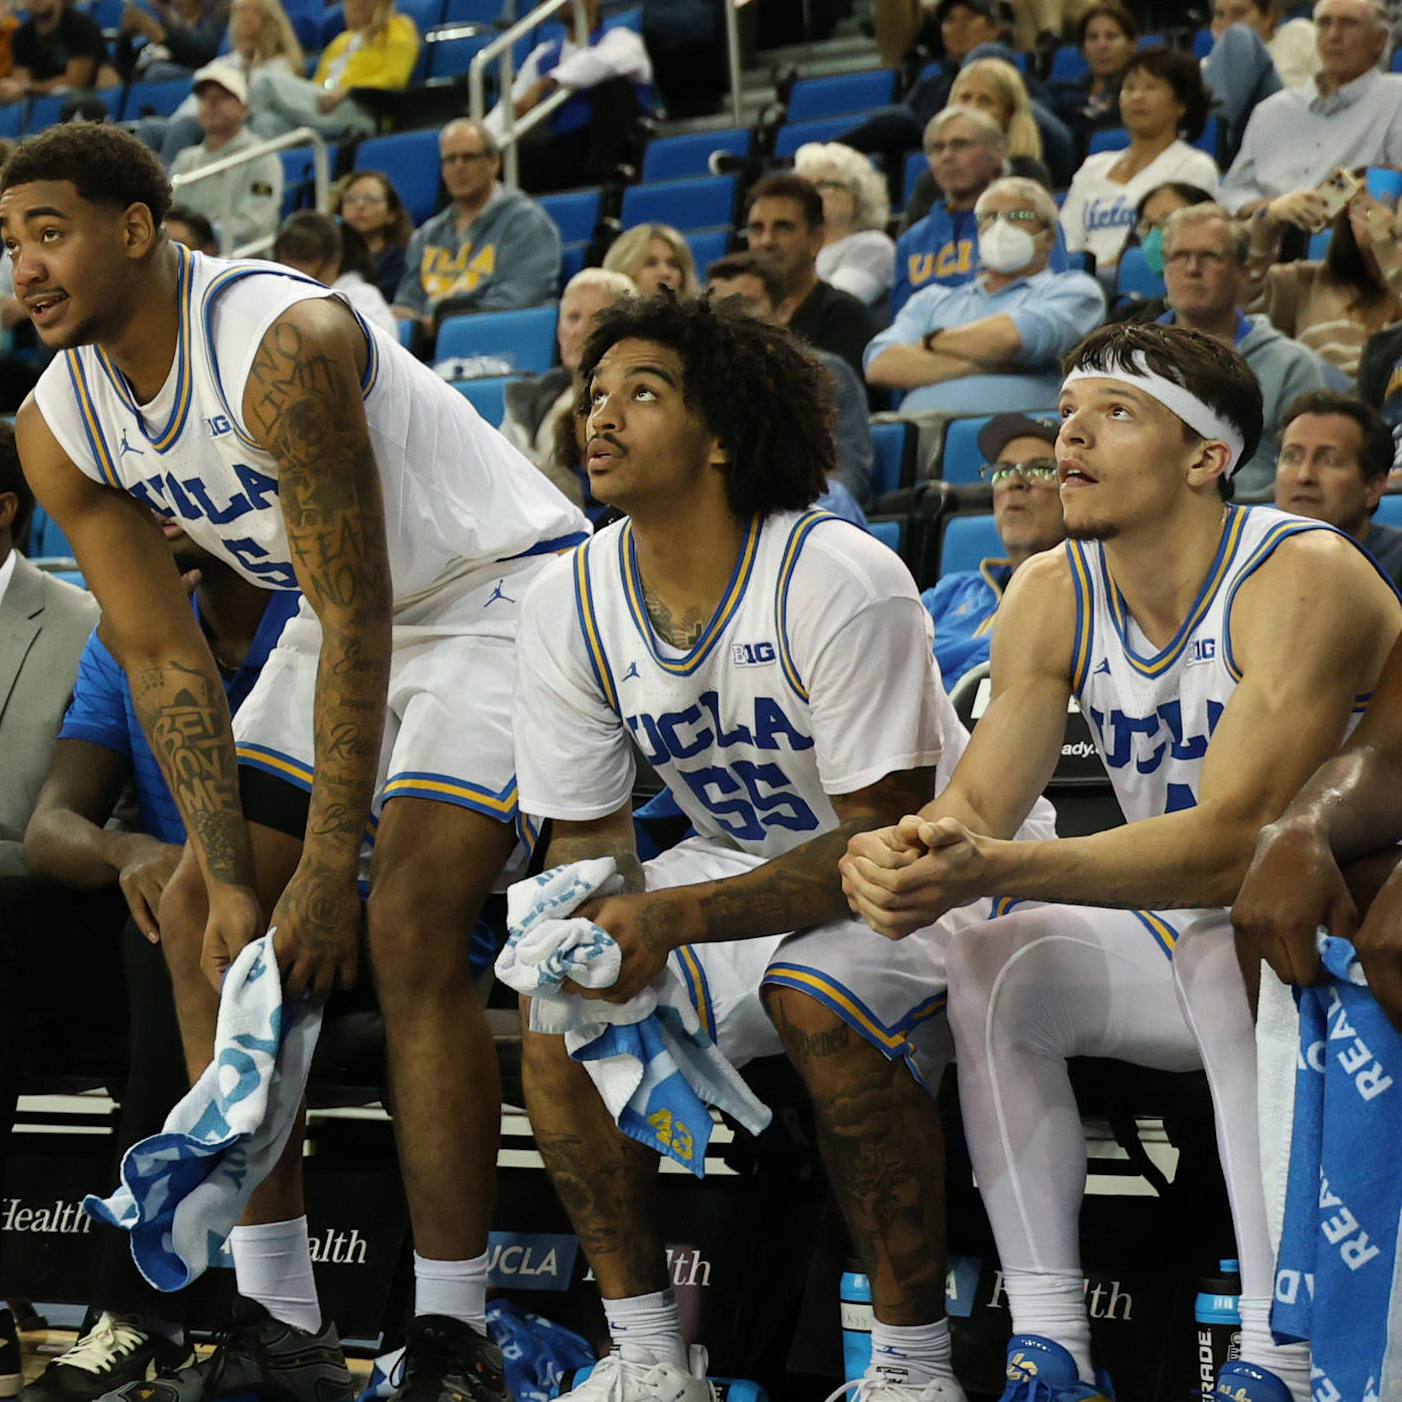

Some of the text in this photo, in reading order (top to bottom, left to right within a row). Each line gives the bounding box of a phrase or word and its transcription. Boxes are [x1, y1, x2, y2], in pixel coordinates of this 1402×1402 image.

[221, 537, 300, 589] 5
[625, 690, 815, 766] UCLA
[678, 759, 820, 841] 55
[308, 1228, 367, 1265] alth
